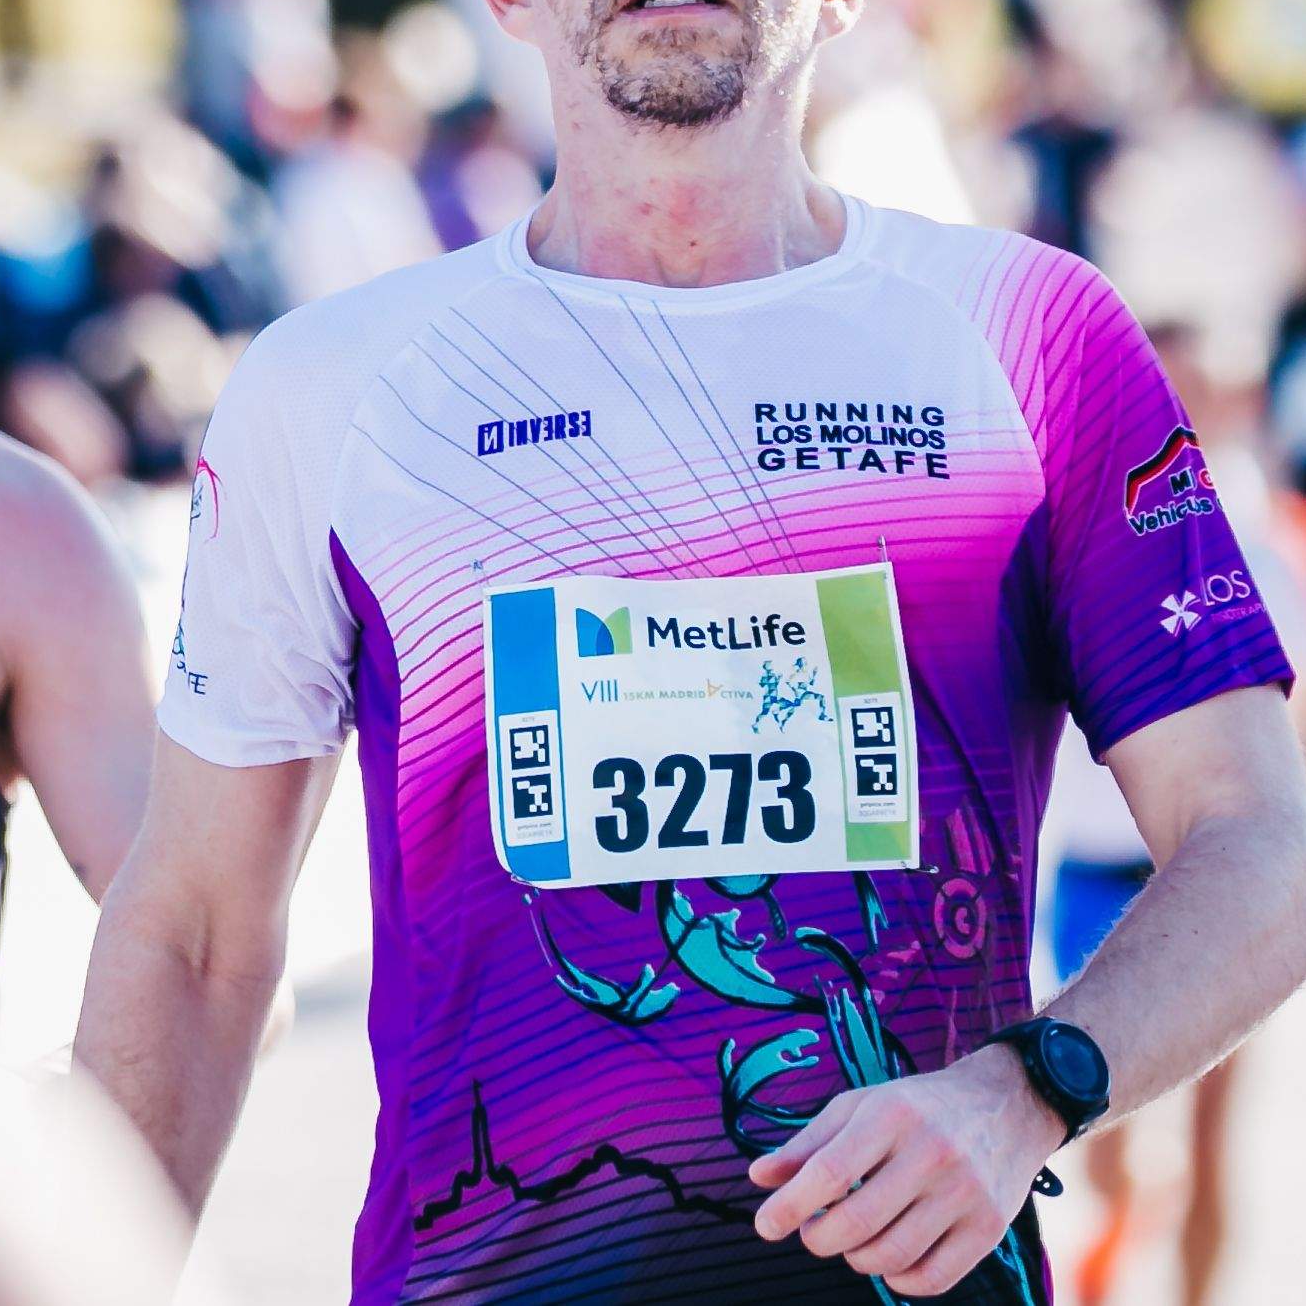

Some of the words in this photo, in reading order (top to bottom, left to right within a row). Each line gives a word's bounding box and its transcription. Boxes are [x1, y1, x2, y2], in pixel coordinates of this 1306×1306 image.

[754, 402, 945, 427] RUNNING
[756, 424, 813, 445] LOS
[819, 424, 946, 450] MOLINOS
[757, 446, 951, 480] GETAFE
[646, 613, 807, 650] MetLife
[580, 679, 619, 703] VIII
[658, 689, 706, 700] MADRID
[592, 750, 816, 854] 3273
